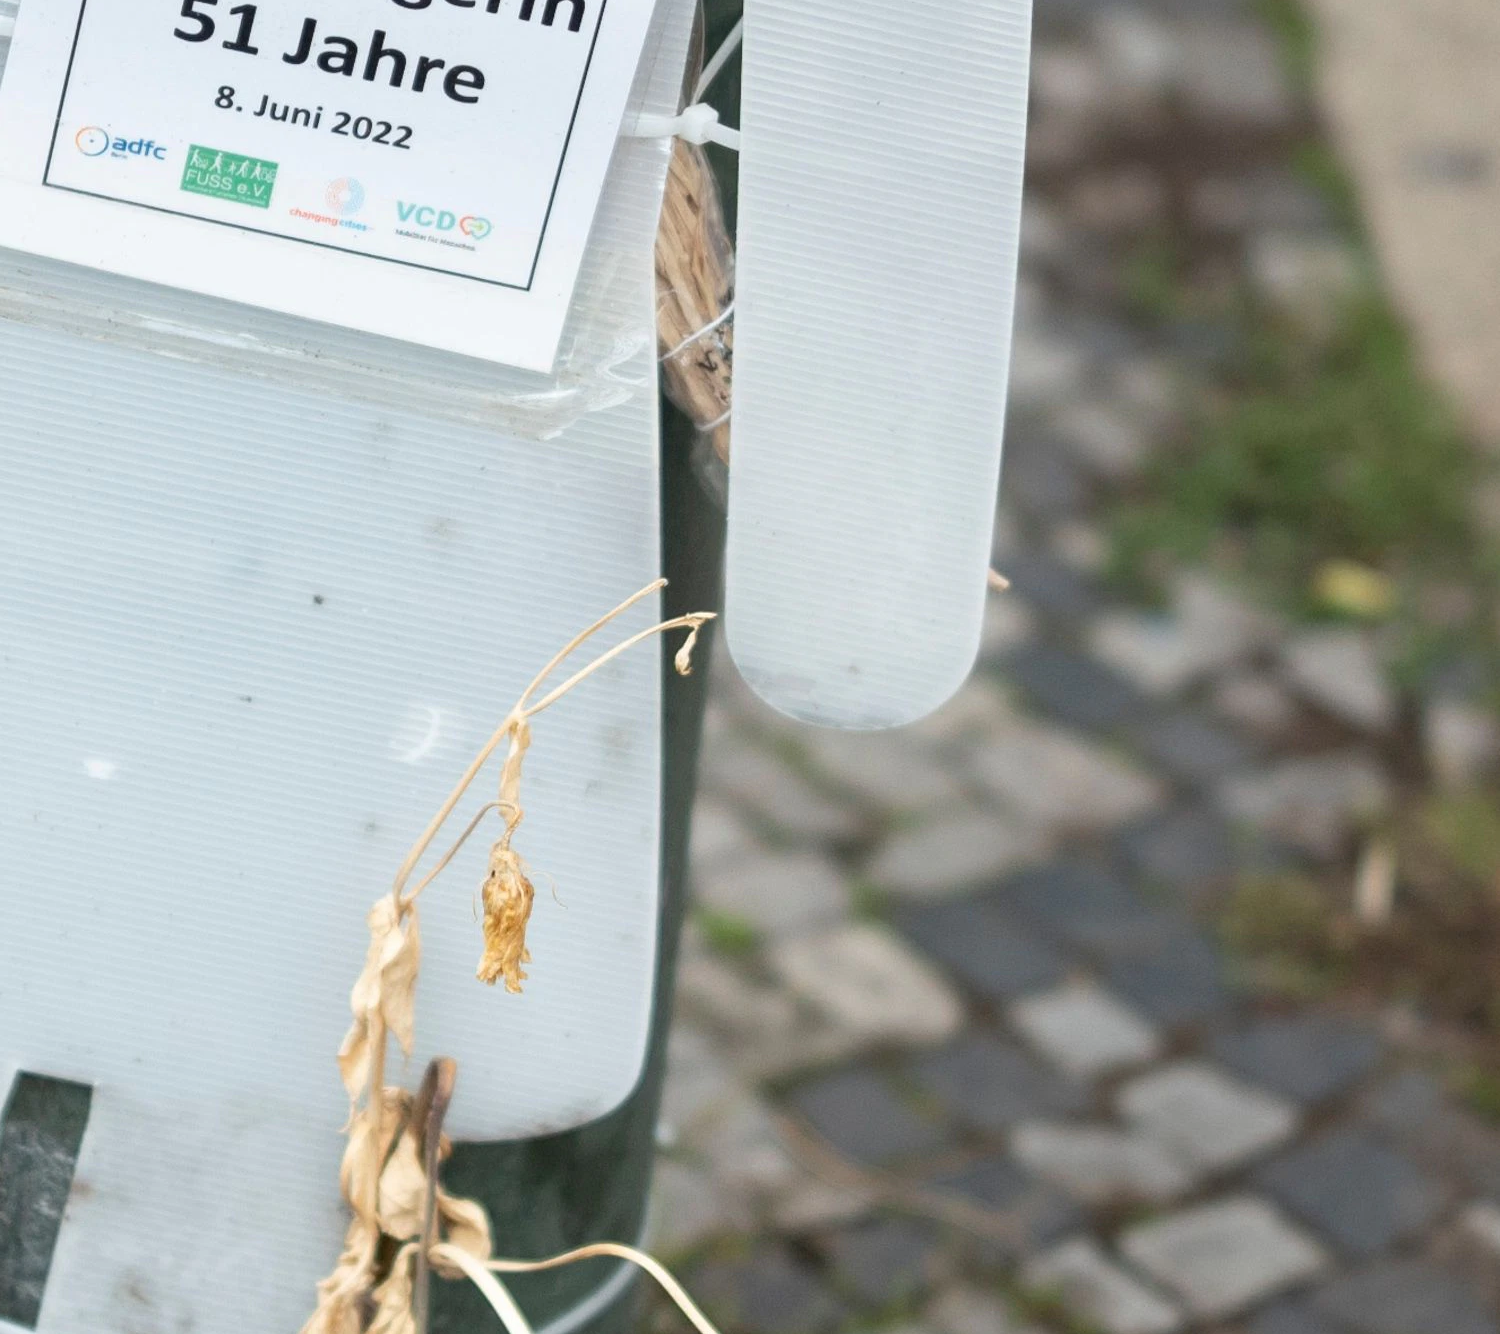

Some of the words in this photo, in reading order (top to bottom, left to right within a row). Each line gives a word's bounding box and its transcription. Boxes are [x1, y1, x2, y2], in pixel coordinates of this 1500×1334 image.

[282, 17, 486, 104] Jahre
[214, 85, 244, 114] 8.
[253, 95, 323, 129] Juni
[331, 111, 413, 150] 2022
[111, 137, 167, 161] adfc
[185, 168, 233, 192] FUSS
[236, 182, 269, 201] e.V.
[395, 200, 457, 231] VCD
